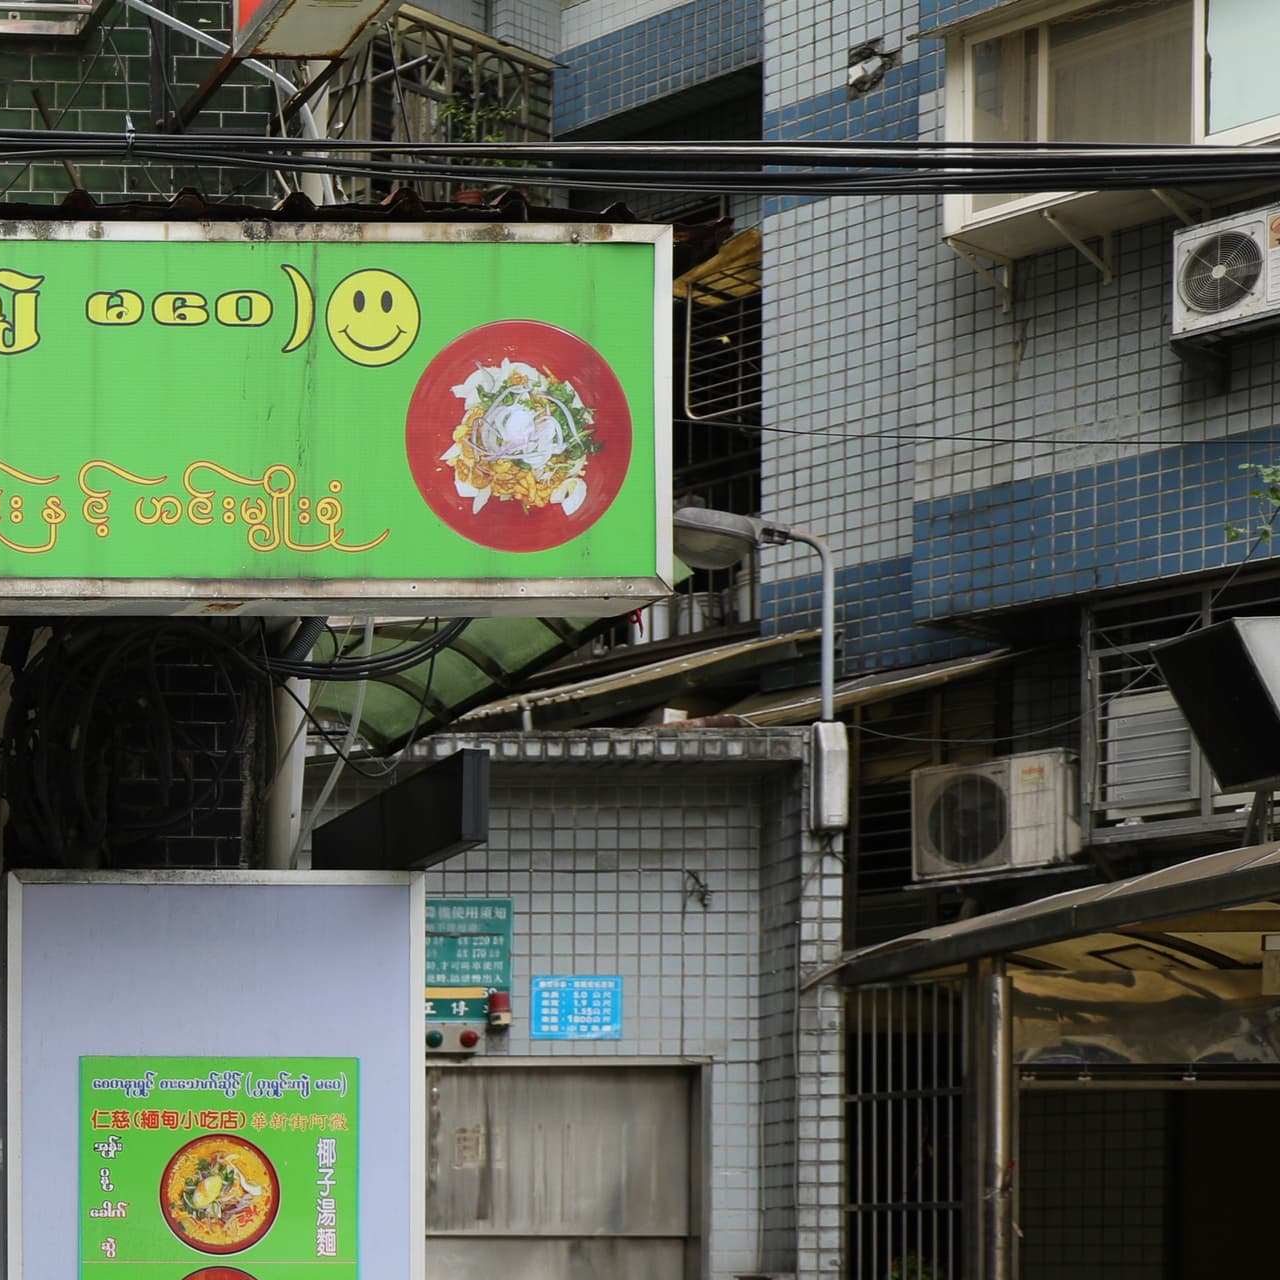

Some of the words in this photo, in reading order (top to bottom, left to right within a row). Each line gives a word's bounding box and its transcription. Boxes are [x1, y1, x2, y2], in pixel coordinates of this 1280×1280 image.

[91, 1110, 246, 1131] 仁慈(緬甸小吃店)
[316, 1137, 337, 1257] 椰子湯麵
